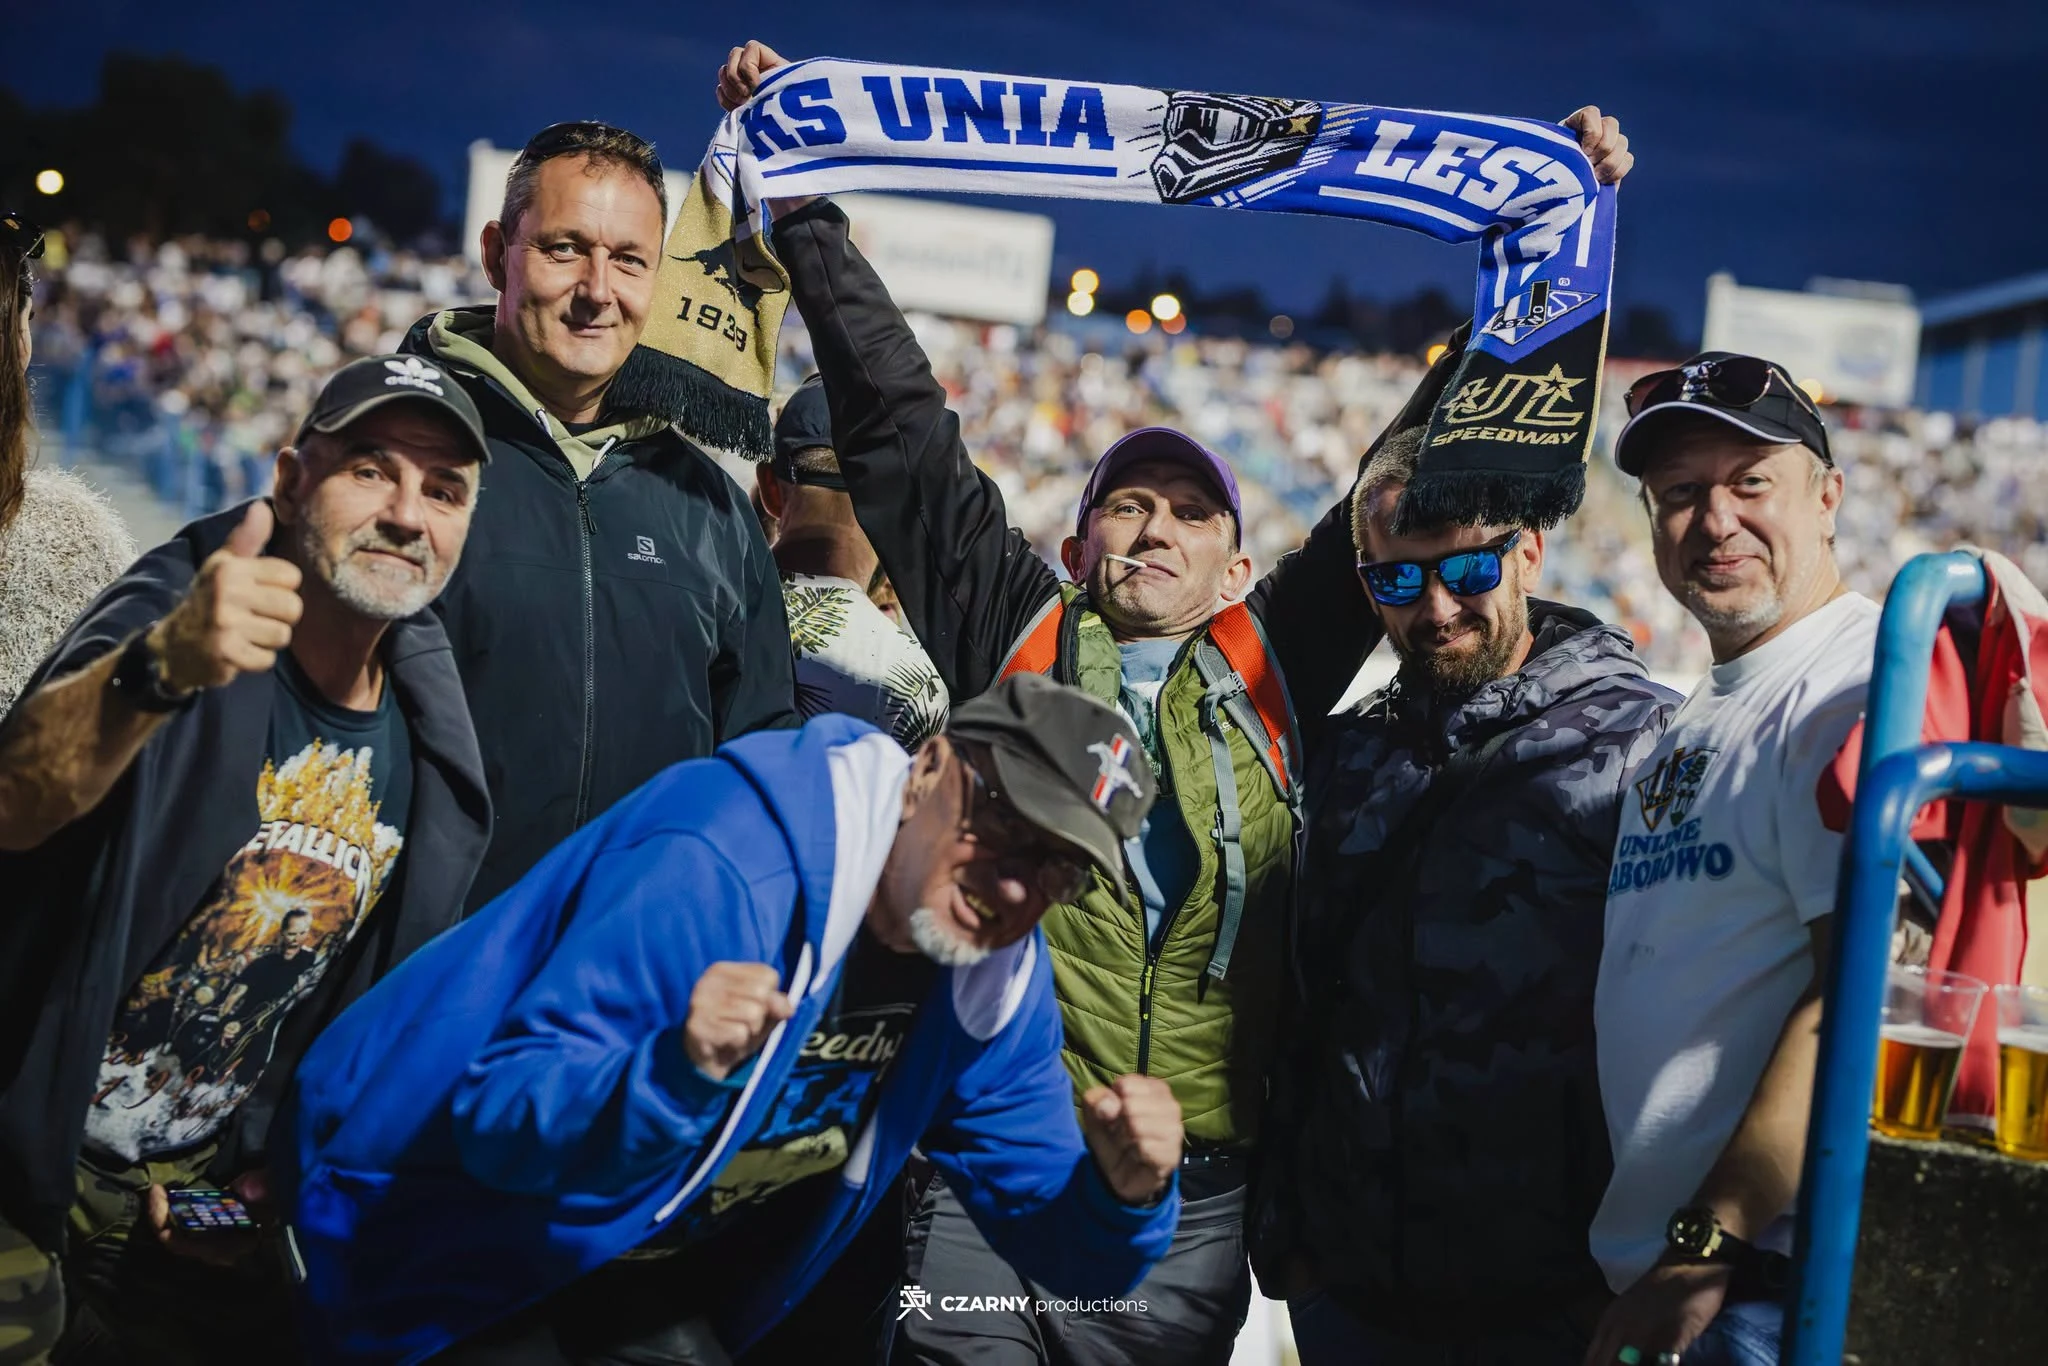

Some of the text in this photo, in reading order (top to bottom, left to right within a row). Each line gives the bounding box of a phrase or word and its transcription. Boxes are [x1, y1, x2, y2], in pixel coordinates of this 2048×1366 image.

[862, 76, 1114, 151] UNIA
[1430, 426, 1579, 447] SPEEDWAY
[226, 821, 374, 942] ETALLICA
